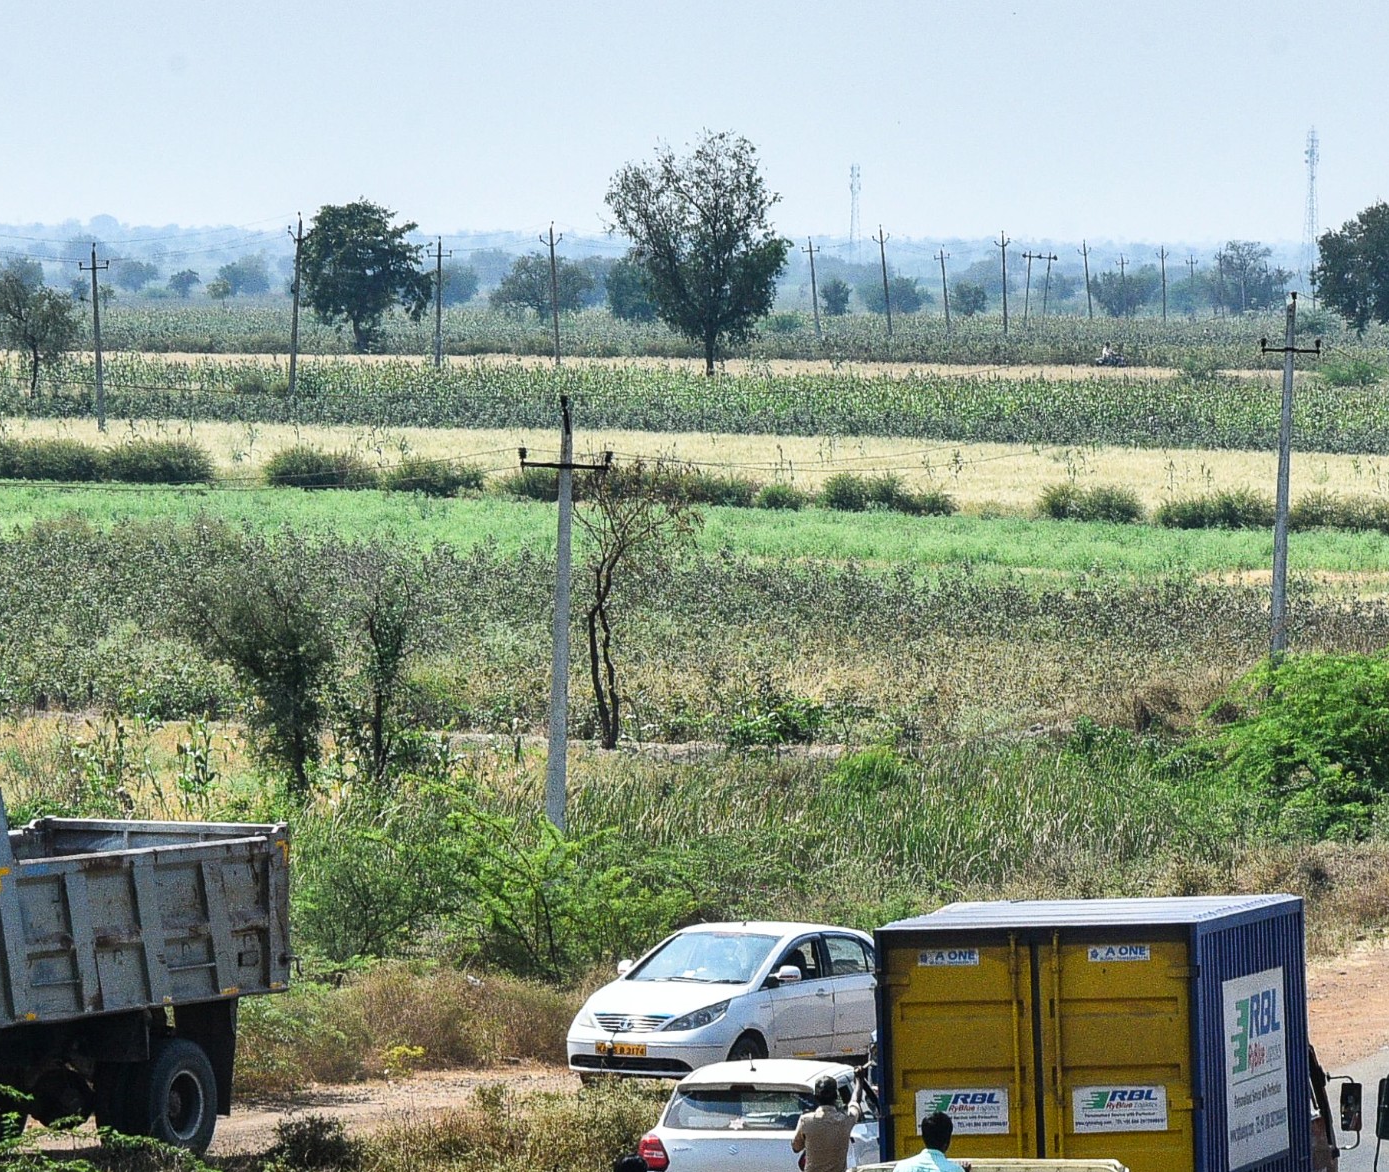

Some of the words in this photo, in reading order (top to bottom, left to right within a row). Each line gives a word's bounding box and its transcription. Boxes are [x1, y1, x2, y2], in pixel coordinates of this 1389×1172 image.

[935, 951, 944, 961] A
[947, 951, 976, 961] ONE
[1105, 947, 1115, 956] A
[1119, 946, 1147, 956] ONE
[1249, 988, 1281, 1039] RBL
[952, 1092, 1000, 1104] RBL
[1110, 1089, 1158, 1101] RBL
